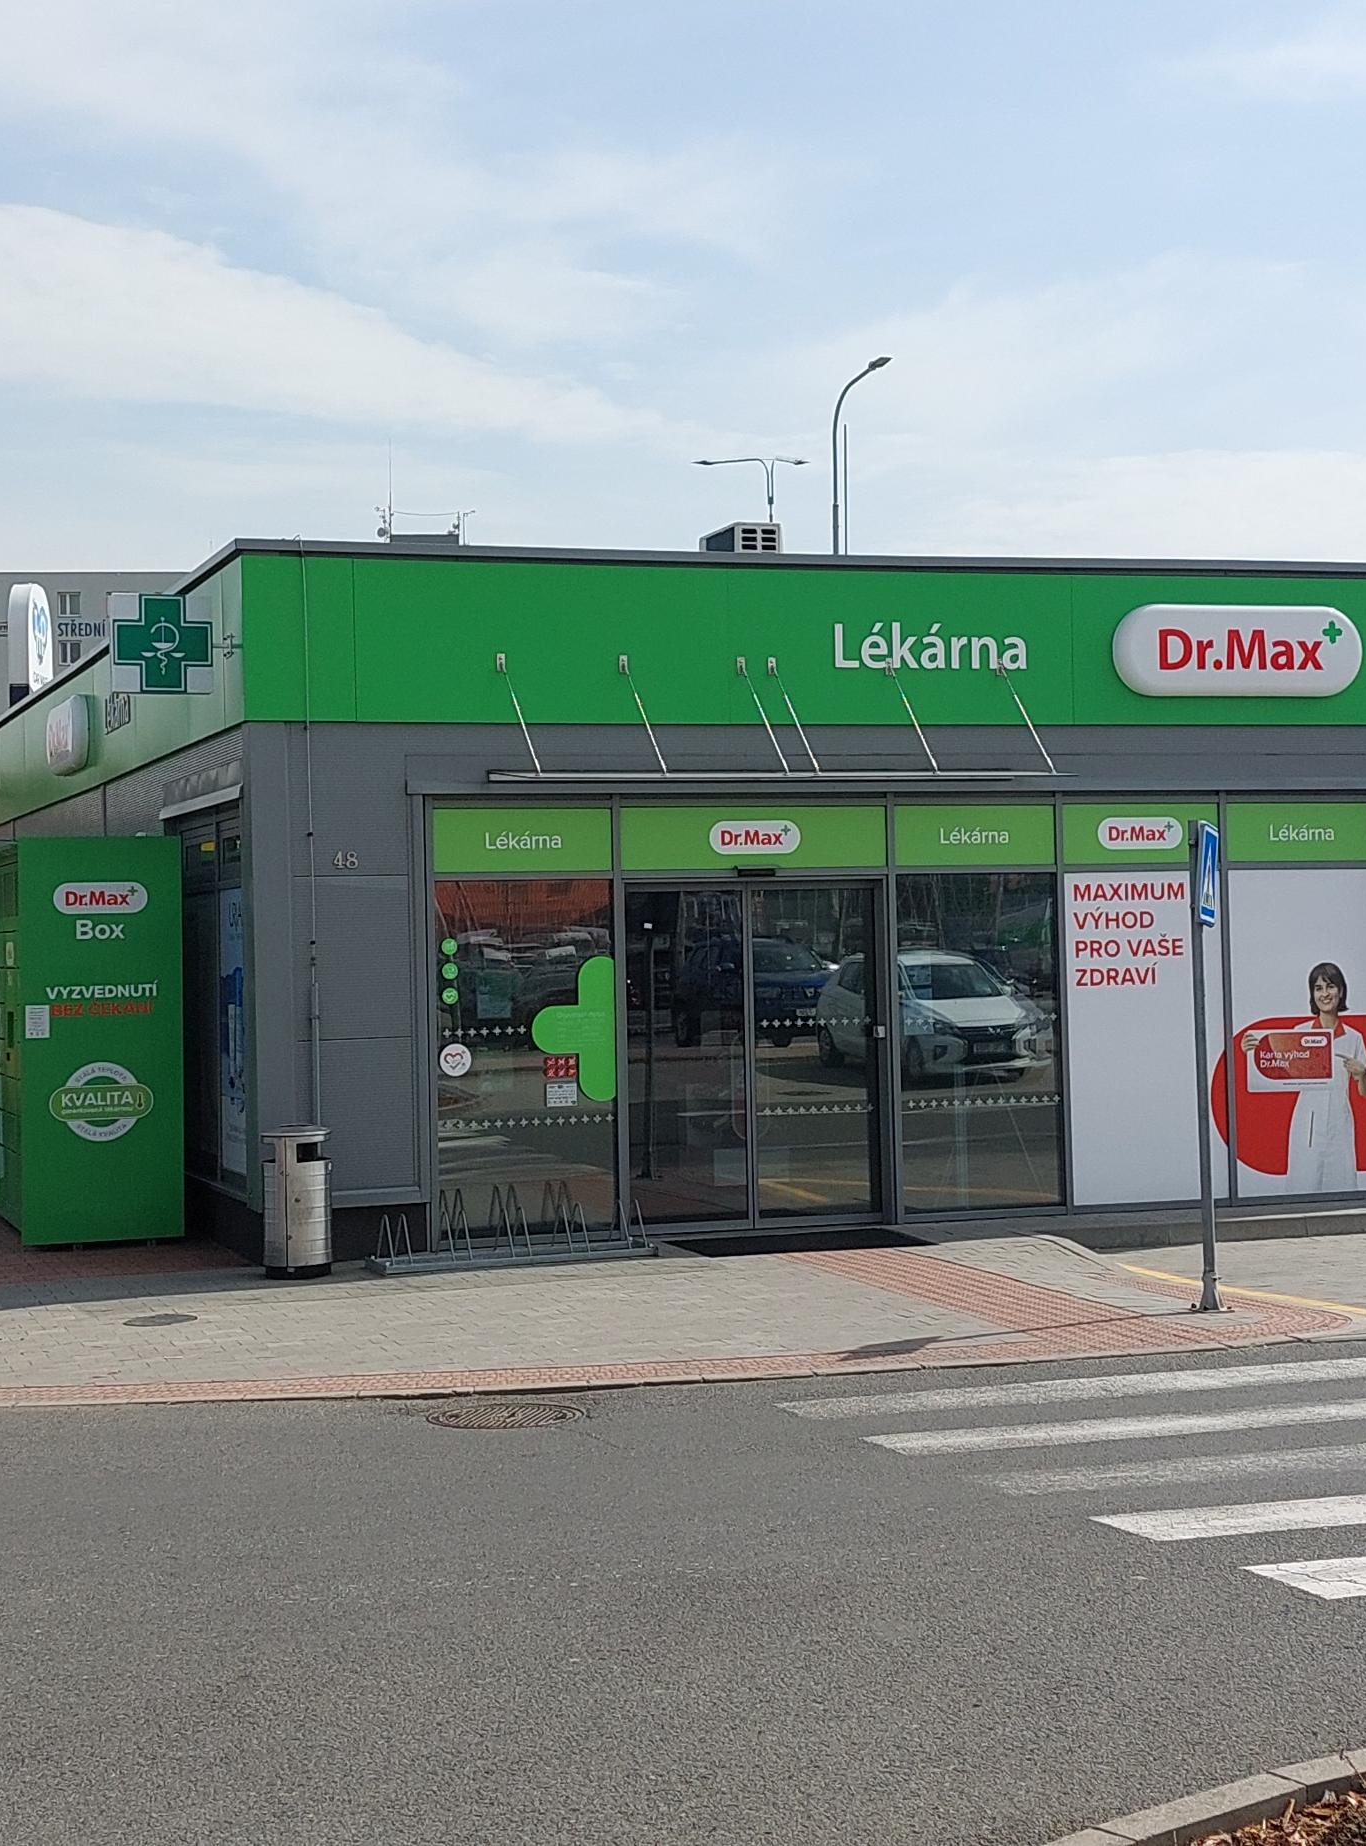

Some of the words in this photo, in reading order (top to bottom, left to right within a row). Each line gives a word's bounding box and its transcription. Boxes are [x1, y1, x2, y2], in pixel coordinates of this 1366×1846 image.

[57, 619, 106, 638] STŘEDNÍ
[834, 621, 1028, 671] Lékárna
[485, 831, 563, 851] Lékárna
[939, 826, 1010, 845] Lékárna
[1269, 823, 1335, 842] Lékárna
[332, 850, 359, 870] 48
[1073, 882, 1186, 903] MAXIMUM
[1073, 906, 1155, 930] VÝHOD
[75, 919, 125, 941] Box
[1075, 939, 1121, 958] PRO
[1127, 932, 1185, 957] VAŠE
[1075, 961, 1158, 987] ZDRAVÍ
[46, 979, 159, 1000] VYZVEDNUTÍ
[50, 1003, 83, 1017] BEZ
[88, 999, 154, 1016] ČEKÁNÍ
[1259, 1051, 1282, 1059] Karta
[1284, 1050, 1310, 1060] výhod
[1260, 1060, 1290, 1068] Dr.Max
[61, 1090, 135, 1108] KVALITA
